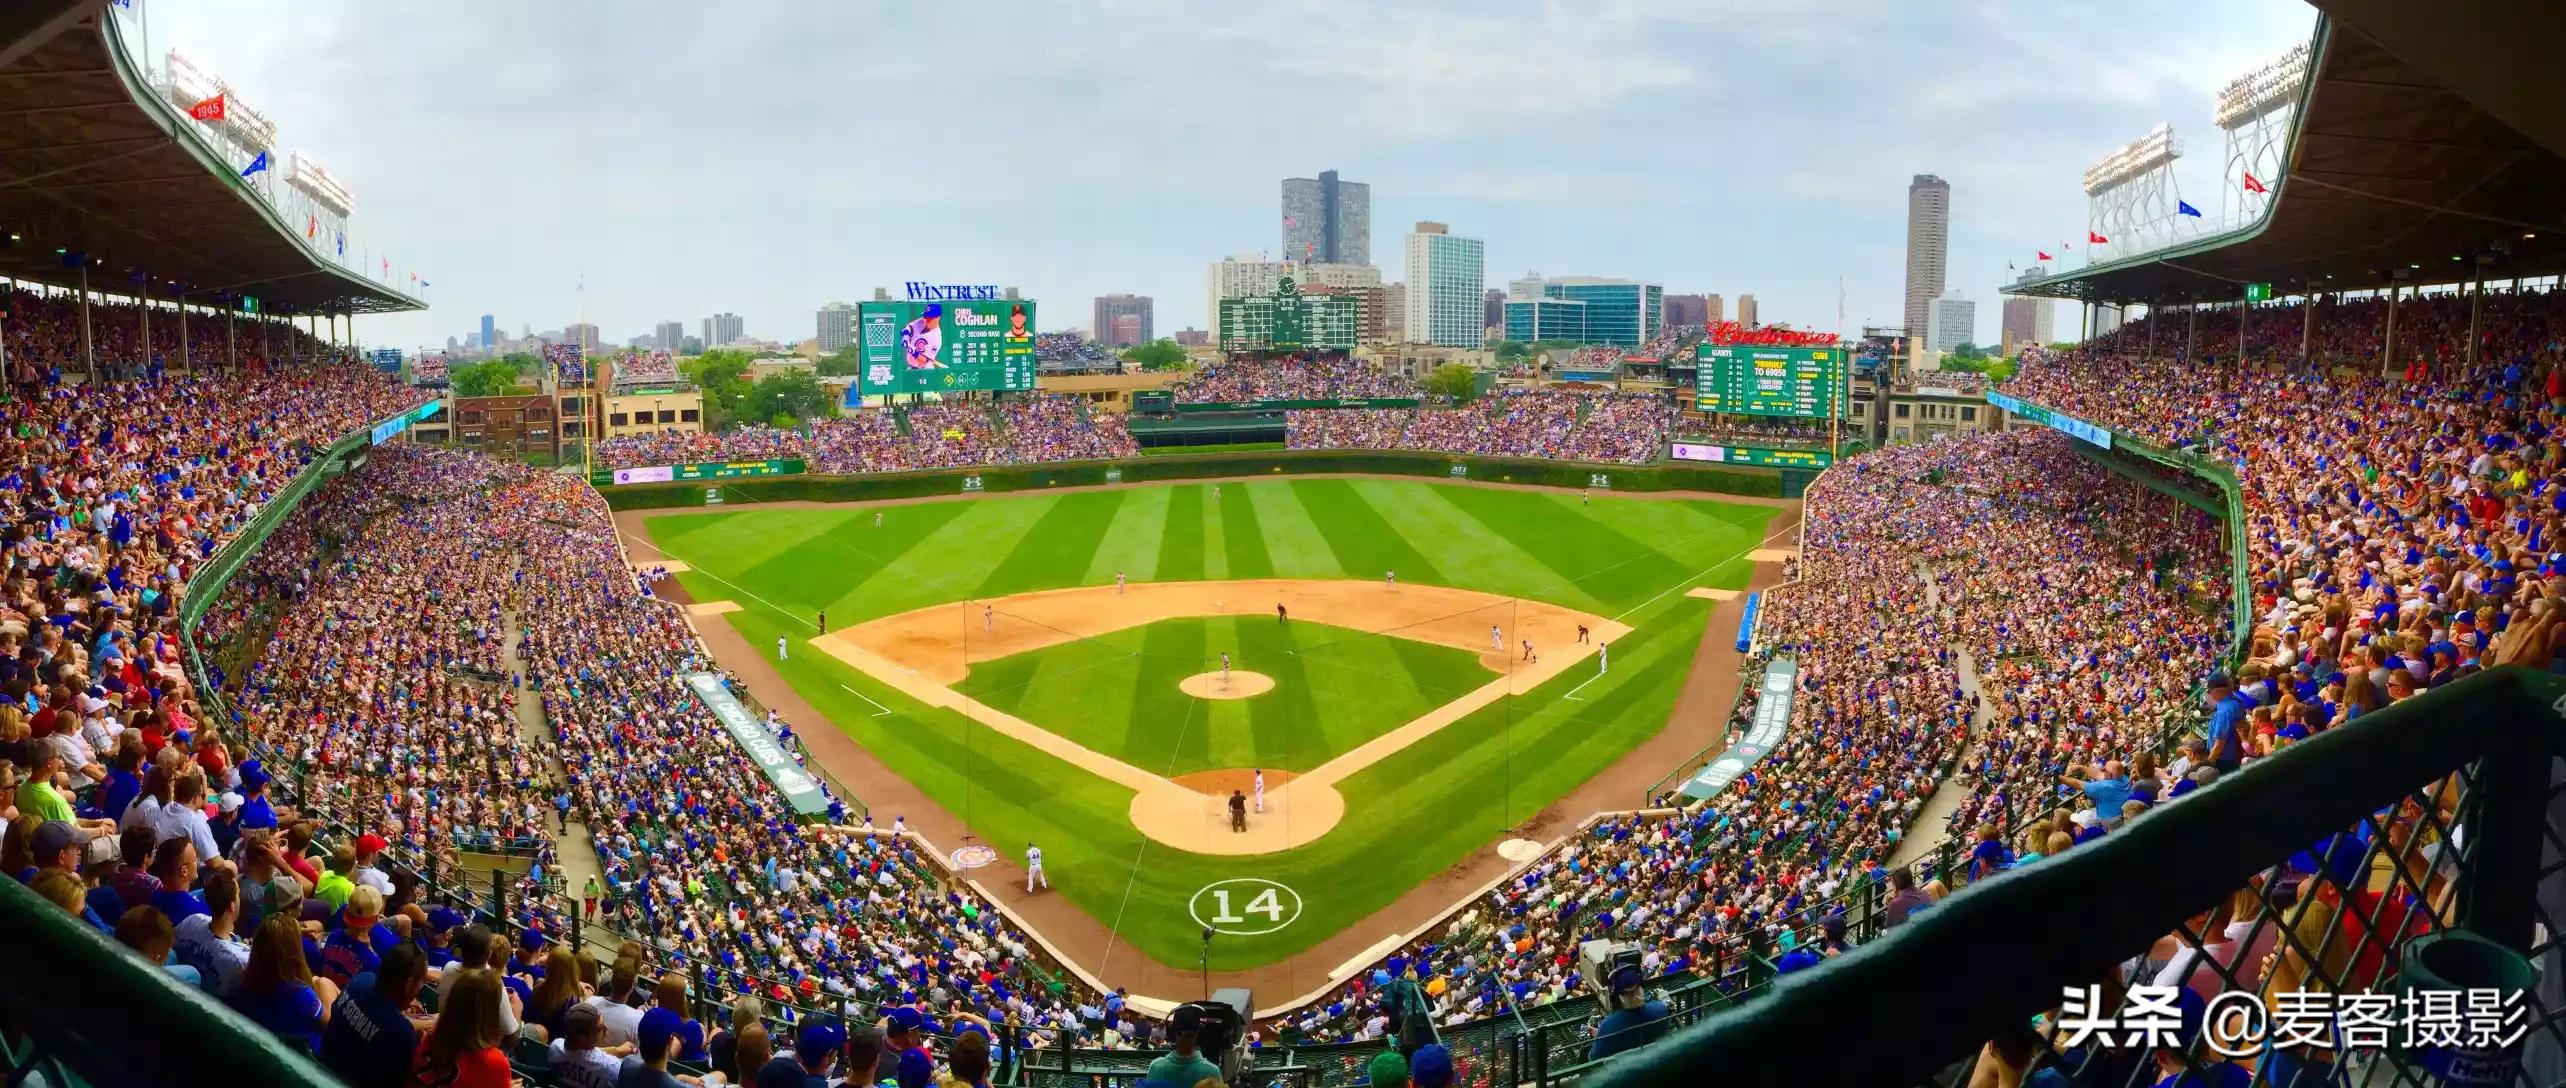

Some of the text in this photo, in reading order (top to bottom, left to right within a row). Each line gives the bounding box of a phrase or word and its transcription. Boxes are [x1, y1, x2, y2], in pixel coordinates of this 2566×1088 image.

[197, 104, 220, 117] 1945
[906, 282, 997, 300] WINTRUST
[954, 308, 972, 316] CHRIS
[954, 315, 998, 326] COGHLAN
[1707, 320, 1838, 346] Budweiser
[1712, 349, 1732, 357] GIANTS
[1812, 352, 1829, 360] CUBS
[1755, 368, 1765, 376] TO
[717, 702, 785, 766] CHICAGO CUBS
[1212, 888, 1284, 923] 14
